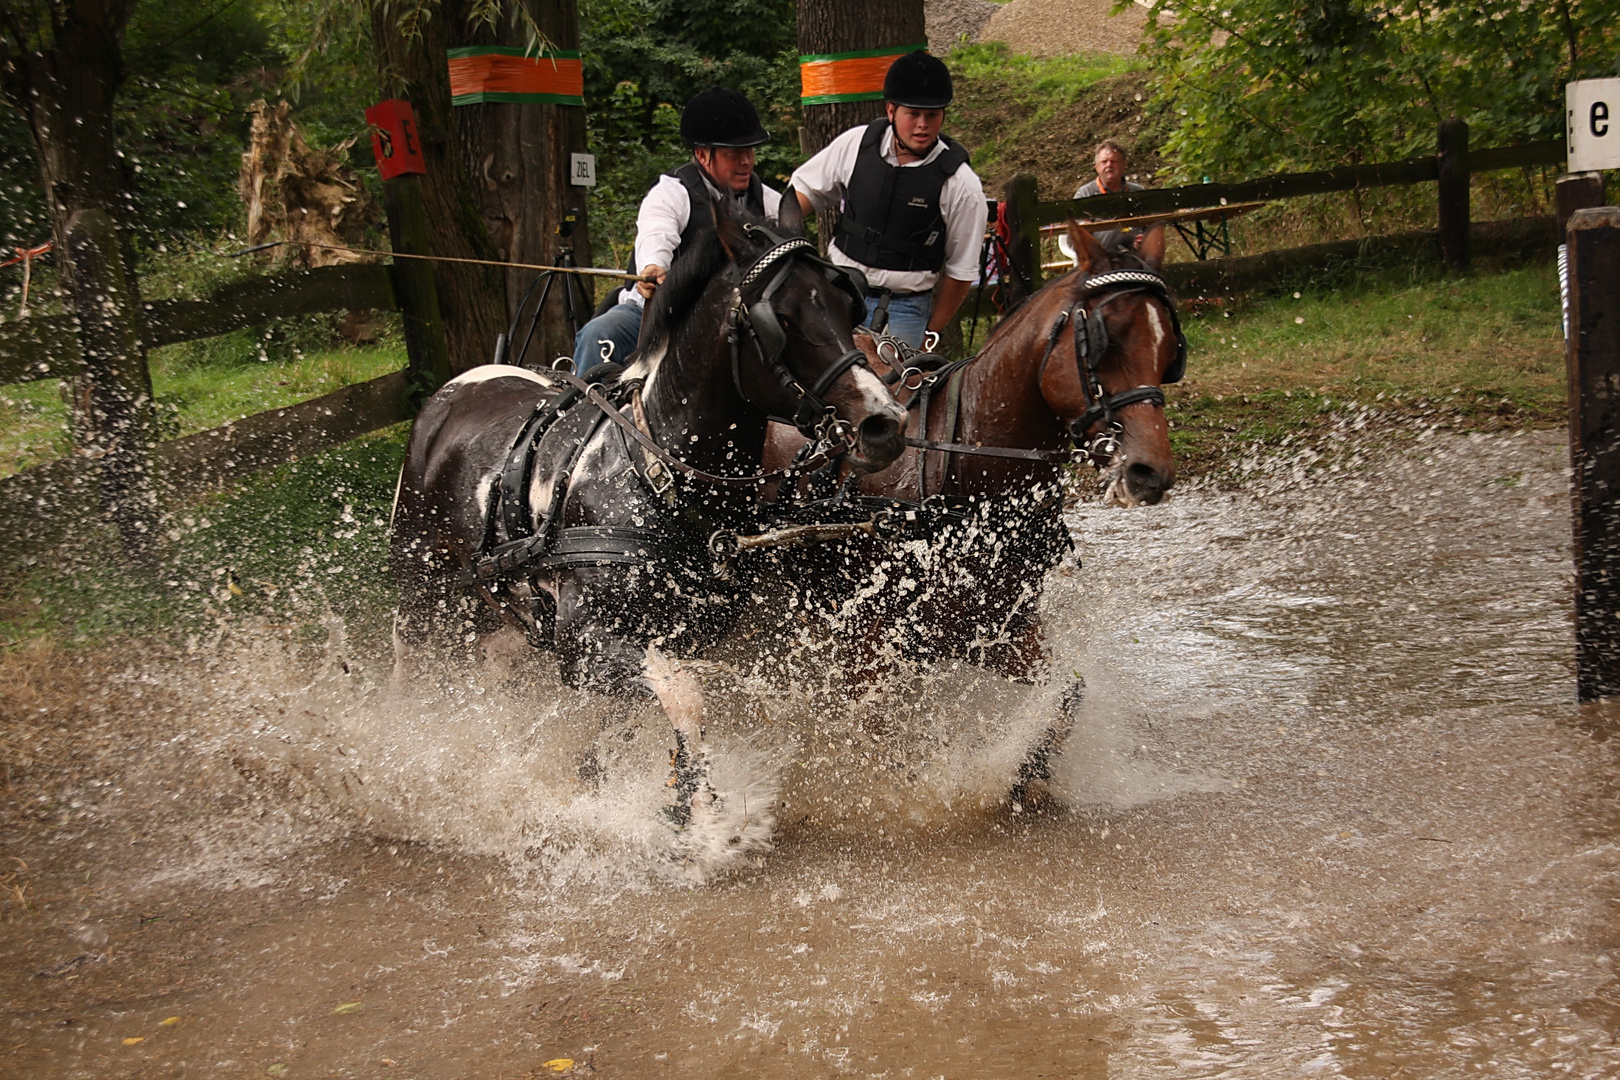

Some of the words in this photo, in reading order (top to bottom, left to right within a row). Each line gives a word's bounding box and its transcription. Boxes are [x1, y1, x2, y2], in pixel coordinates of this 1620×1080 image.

[402, 119, 417, 155] E
[1590, 102, 1609, 138] e
[577, 161, 590, 178] ZIEL
